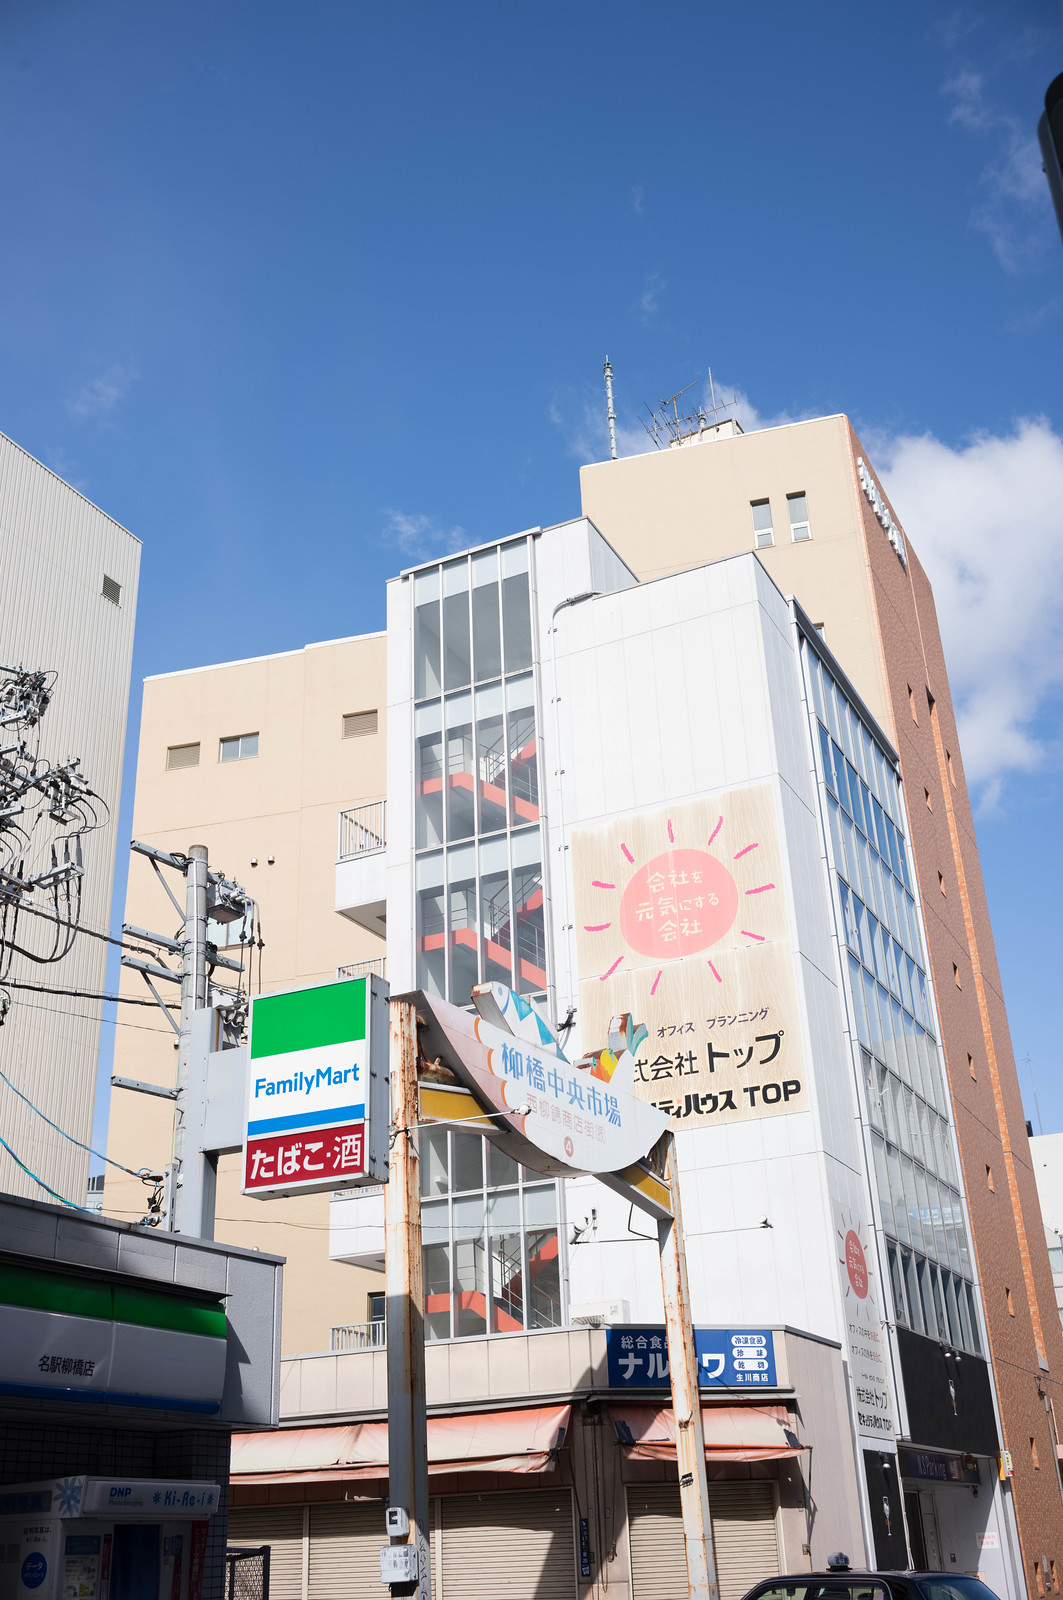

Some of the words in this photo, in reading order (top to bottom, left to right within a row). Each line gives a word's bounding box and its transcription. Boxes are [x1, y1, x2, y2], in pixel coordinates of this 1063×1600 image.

[646, 870, 703, 893] 会社を
[635, 893, 720, 921] 元気にする
[658, 919, 702, 942] 会社
[657, 1022, 695, 1038] オフィス
[706, 1007, 770, 1029] プランニング
[707, 1030, 785, 1073] トップ
[254, 1063, 360, 1098] FamilyMart
[501, 1042, 622, 1128] 柳橋中央市場
[650, 1090, 738, 1119] ティハウス
[743, 1079, 801, 1107] TOP
[620, 1335, 668, 1350] 総合食
[734, 1336, 764, 1346] 冷凍食品
[38, 1354, 96, 1378] 名駅柳橋店
[618, 1352, 726, 1380] ナルワ
[736, 1372, 769, 1382] 生川商店
[110, 1487, 132, 1497] DNP
[164, 1490, 206, 1507] Ki-Re-i
[25, 1562, 43, 1571] データ
